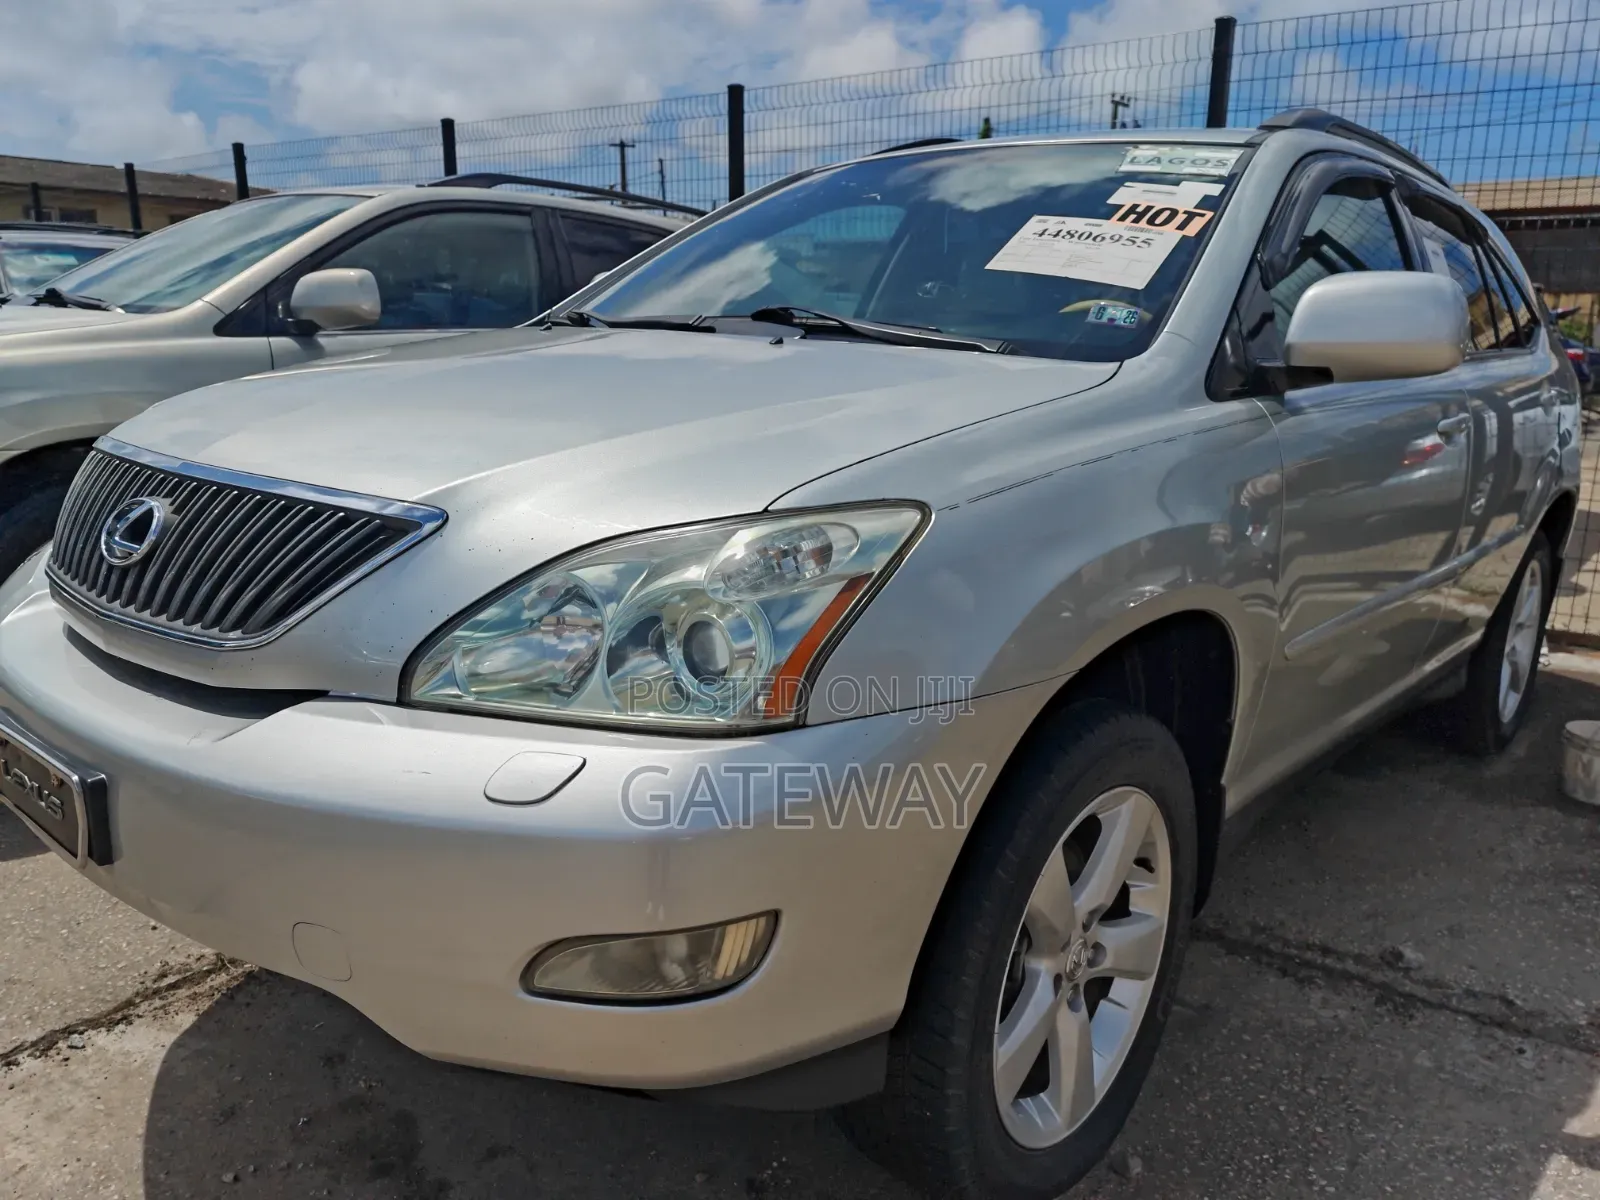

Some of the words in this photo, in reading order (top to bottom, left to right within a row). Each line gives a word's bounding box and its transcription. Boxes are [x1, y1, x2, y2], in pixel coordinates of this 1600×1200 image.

[1128, 155, 1231, 167] LAGOS
[1116, 203, 1207, 231] HOT
[1032, 227, 1156, 249] 44806955
[1122, 309, 1138, 325] 26
[1, 758, 65, 822] LEXUS
